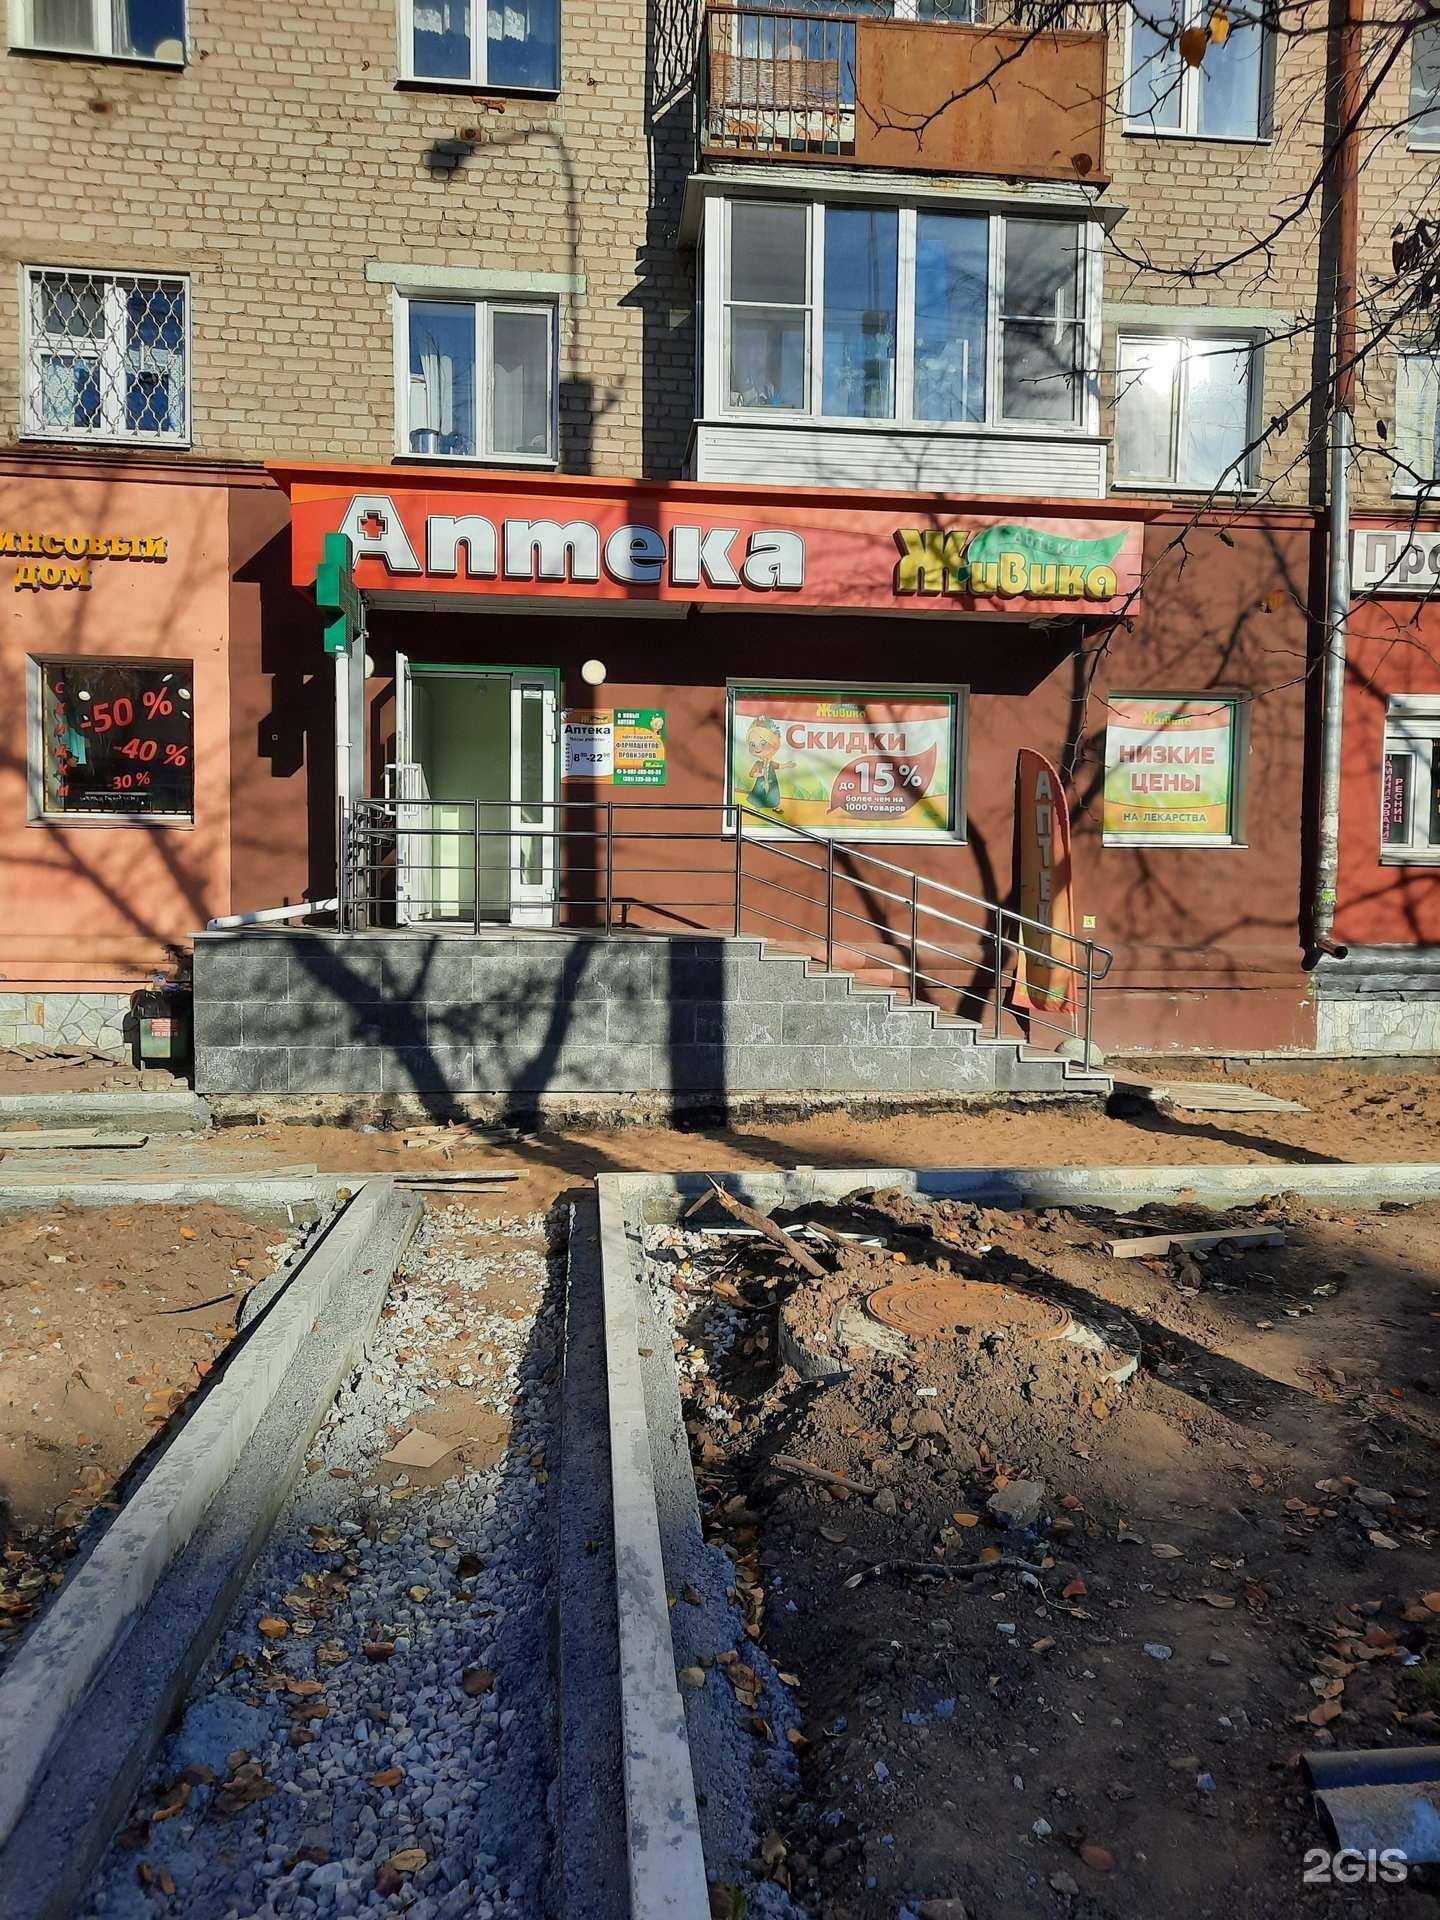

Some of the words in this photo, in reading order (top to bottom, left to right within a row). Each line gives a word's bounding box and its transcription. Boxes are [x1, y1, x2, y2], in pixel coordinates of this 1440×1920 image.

[338, 494, 806, 590] Аптека
[893, 529, 1117, 601] Живика
[14, 563, 92, 592] ДОМ
[80, 697, 133, 733] -50
[142, 686, 173, 720] %
[564, 725, 611, 735] Аптека
[786, 724, 906, 753] Скидки
[163, 744, 189, 766] %
[1119, 745, 1216, 764] НИЗКИЕ
[839, 782, 855, 792] до
[1131, 773, 1201, 794] ЦЕНЫ
[845, 803, 867, 812] 1000
[869, 804, 906, 812] товаров
[1393, 778, 1404, 823] РЕСНИЦ
[1123, 813, 1138, 821] НА
[1143, 813, 1206, 822] ЛЕКАРСТВА
